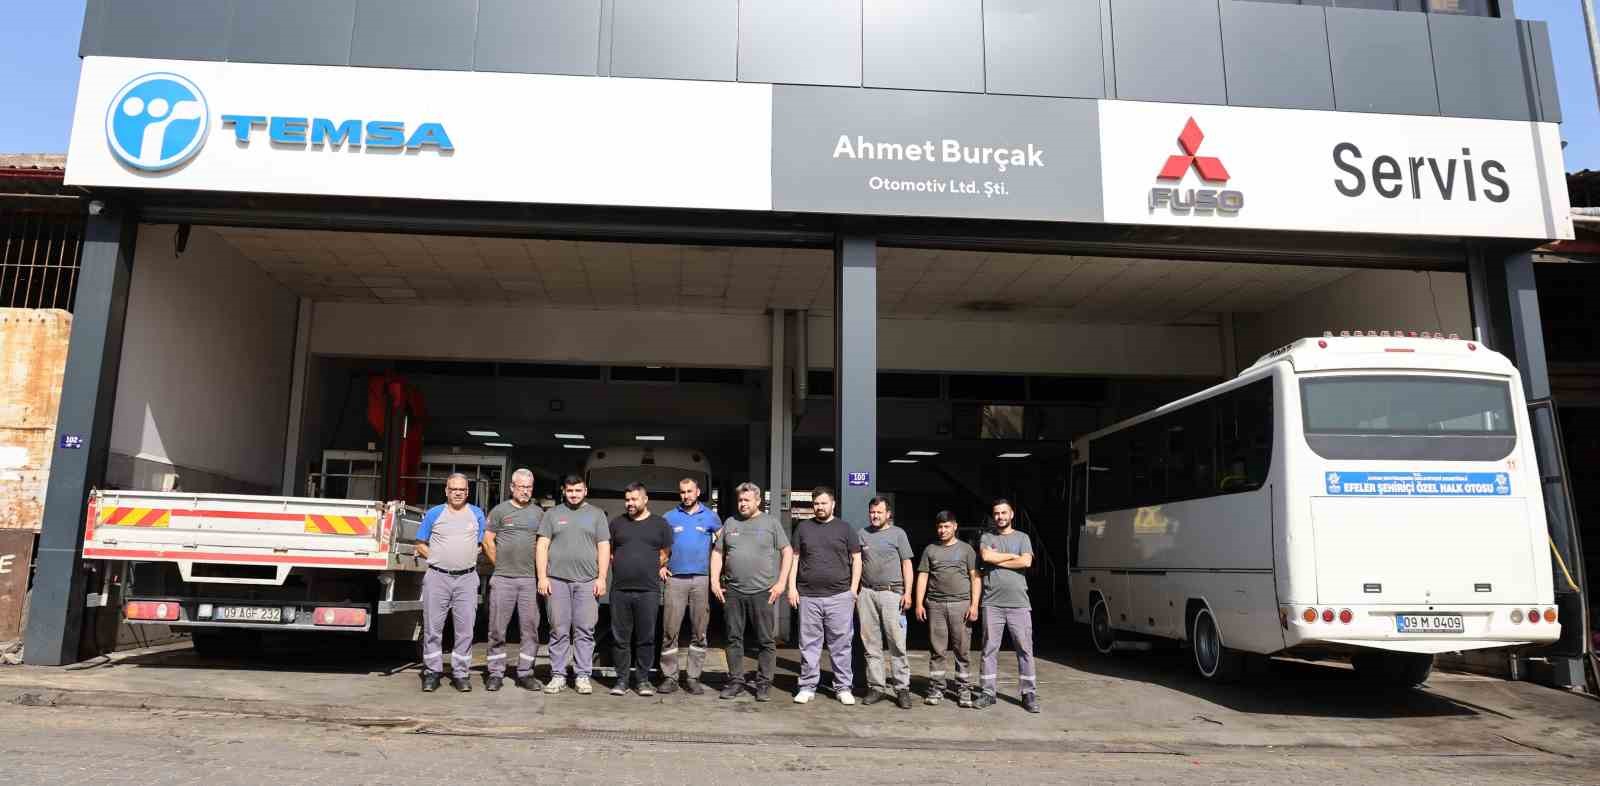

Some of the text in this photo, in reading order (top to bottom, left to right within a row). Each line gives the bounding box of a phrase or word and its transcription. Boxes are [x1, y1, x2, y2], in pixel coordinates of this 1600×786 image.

[221, 114, 455, 157] TEMSA
[832, 134, 1045, 172] Ahmet Burçak
[1332, 141, 1511, 203] Servis
[868, 176, 1009, 198] Otomotiv Ltd. Şti.
[1149, 187, 1245, 216] FUSO
[1343, 482, 1377, 493] EFELER
[1416, 480, 1439, 494] ÖZEL
[1440, 483, 1464, 494] HALK
[224, 607, 236, 618] 09
[261, 608, 280, 620] 232
[1404, 616, 1461, 629] 09 M 0409
